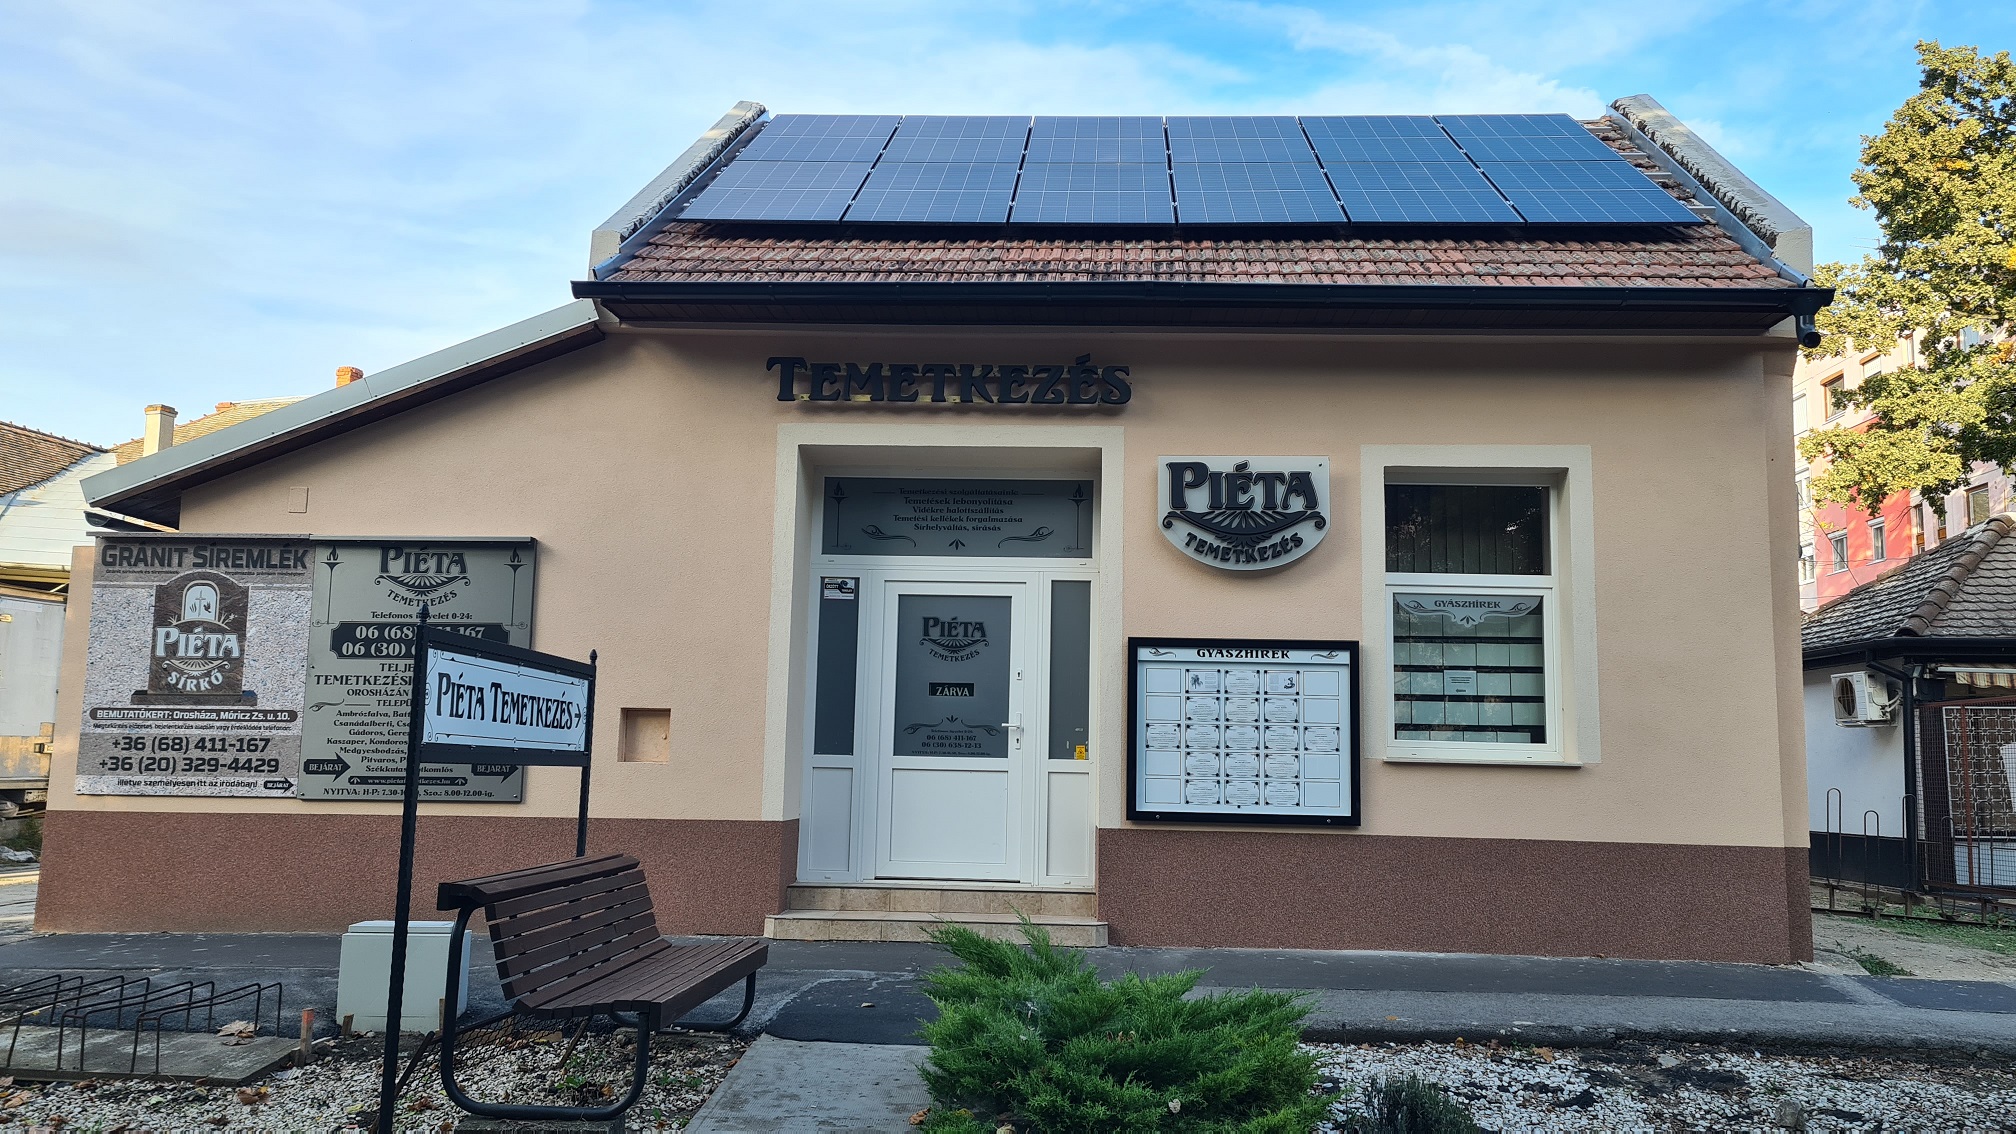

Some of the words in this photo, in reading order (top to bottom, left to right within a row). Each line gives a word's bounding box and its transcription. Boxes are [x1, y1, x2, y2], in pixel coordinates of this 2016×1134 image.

[766, 353, 1132, 405] TEMETKEZÉS
[1166, 460, 1319, 510] PIÉTA
[904, 497, 951, 505] Temetések
[953, 497, 1013, 507] lebonyolítása
[913, 506, 944, 514] Vidékre
[947, 507, 1004, 515] halottszállítás
[893, 515, 928, 523] Temetési
[930, 515, 964, 523] kellékek
[966, 515, 1023, 524] forgalmazása
[914, 523, 970, 532] Sírhelyváltás,
[972, 524, 1002, 532] sírásás
[1185, 532, 1303, 564] TEMETKEZÉS
[101, 541, 189, 568] GRÁNIT
[192, 542, 308, 570] SÍREMLÉK
[379, 546, 468, 575] PIÉTA
[387, 589, 457, 607] TEMETKEZÉS
[1434, 599, 1501, 609] GYÁSZHÍREK
[371, 611, 413, 620] Telefonos
[451, 612, 473, 620] 0-24:
[355, 625, 378, 639] 06
[922, 617, 986, 638] PIÉTA
[155, 626, 240, 658] PIÉTA
[342, 642, 365, 656] 06
[370, 642, 406, 657] (30)
[929, 648, 980, 662] TEMETKEZÉS
[168, 670, 224, 692] SÍRKŐ
[314, 673, 413, 685] TEMETKEZÉSI
[347, 688, 409, 697] OROSHÁZÁN
[936, 684, 969, 697] ZÁRVA
[437, 671, 484, 721] PIÉTA
[490, 682, 573, 730] TEMETKEZÉS
[97, 709, 172, 719] BEMUTATÓKERT:
[174, 710, 218, 721] Orosháza,
[220, 711, 250, 720] Móricz
[251, 712, 265, 720] Zs.
[277, 712, 290, 720] 10.
[336, 710, 390, 718] Ambrózfalva,
[334, 720, 394, 728] Csanádalberti,
[349, 728, 385, 737] Gádoros,
[937, 734, 952, 742] (68)
[112, 736, 146, 751] +36
[152, 736, 189, 753] (68)
[195, 737, 271, 752] 411-167
[327, 737, 367, 746] Kaszaper,
[932, 741, 947, 749] (30)
[339, 747, 407, 756] Medgyesbodzás,
[99, 756, 133, 772] +36
[138, 757, 176, 774] (20)
[182, 757, 279, 773] 329-4429
[361, 756, 398, 764] Pitvaros,
[309, 762, 343, 772] BEJÁRAT
[117, 779, 142, 787] illetve
[143, 779, 196, 788] személyesen
[219, 779, 258, 788] irodában!
[323, 787, 361, 796] NYITVA:
[362, 788, 380, 796] H-P:
[423, 789, 442, 797] Szo.:
[444, 789, 494, 798] 8.00-12.00-ig.
